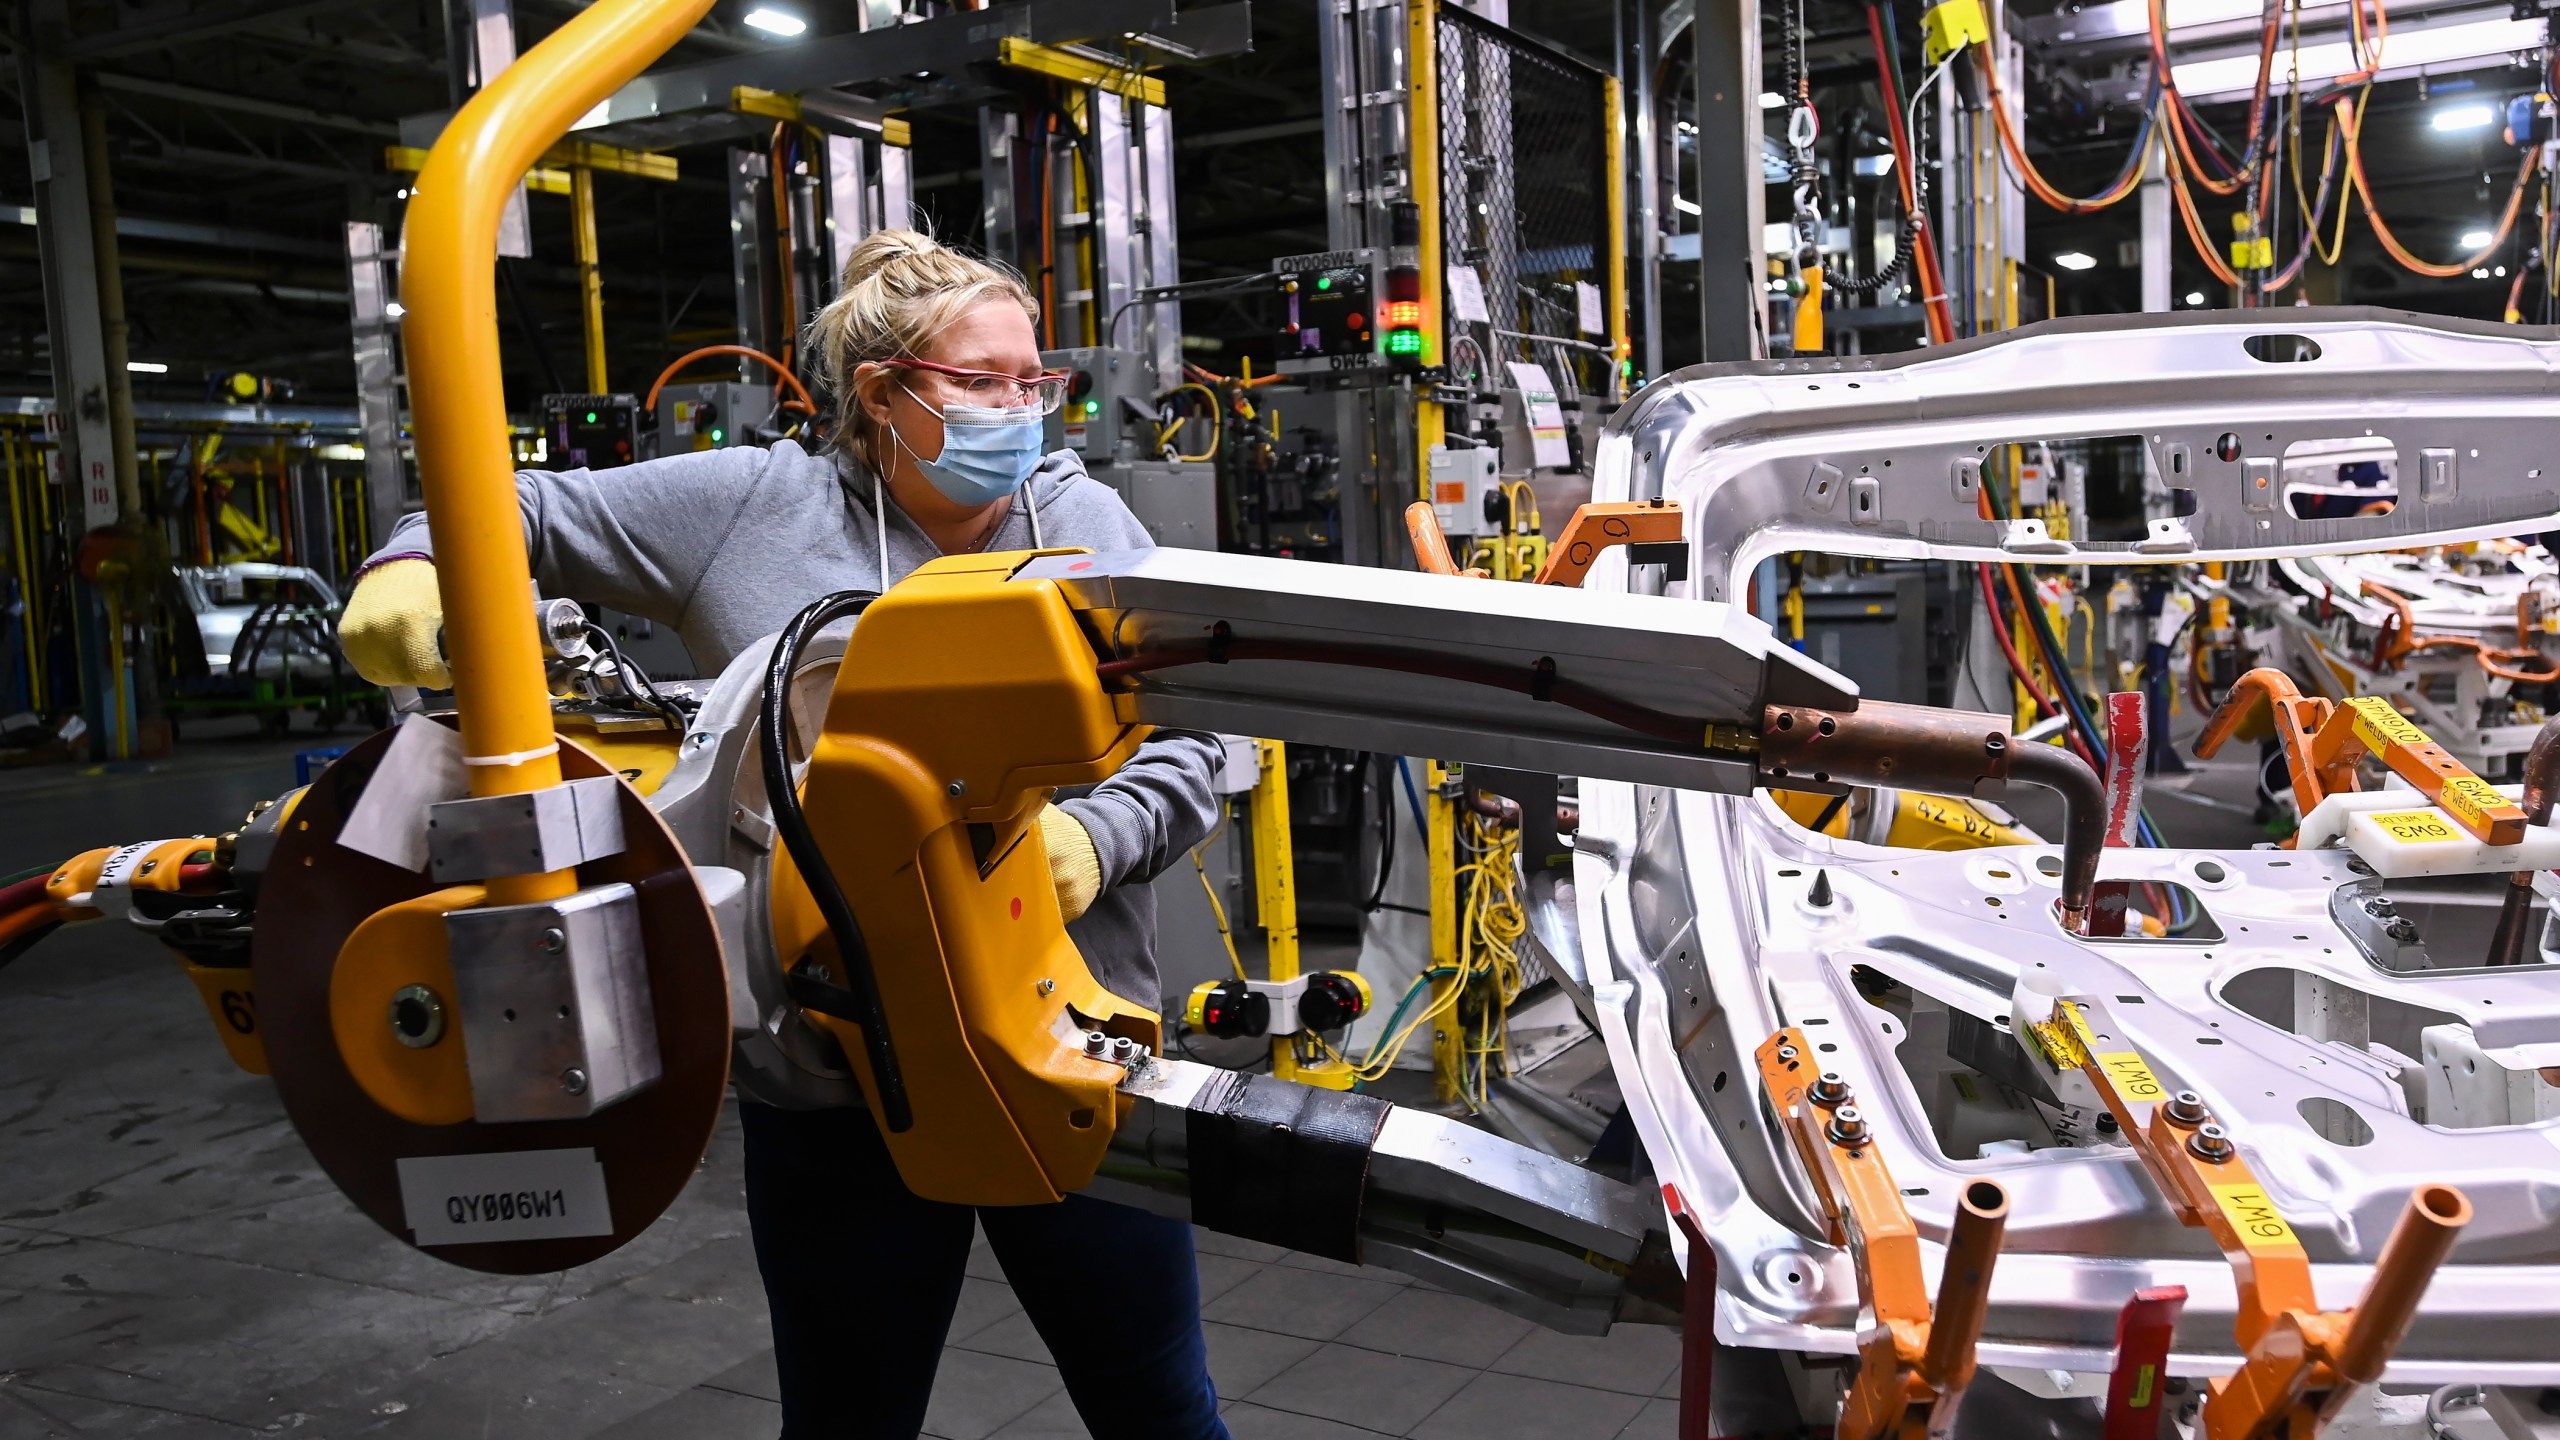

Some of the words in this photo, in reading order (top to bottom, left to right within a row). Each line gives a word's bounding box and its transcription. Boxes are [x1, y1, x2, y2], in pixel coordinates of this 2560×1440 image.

[1281, 251, 1354, 272] QY006W4
[1330, 354, 1368, 369] 6W4
[2365, 717, 2387, 746] WELDS
[2443, 785, 2449, 797] 2
[2452, 789, 2479, 819] WELDS
[2456, 781, 2501, 804] 6W3
[2374, 815, 2422, 824] WELDS
[2392, 824, 2447, 837] 6W3
[2109, 1061, 2159, 1095] 6W1
[447, 1189, 566, 1224] QY006W1
[2229, 1195, 2283, 1237] 6W1
